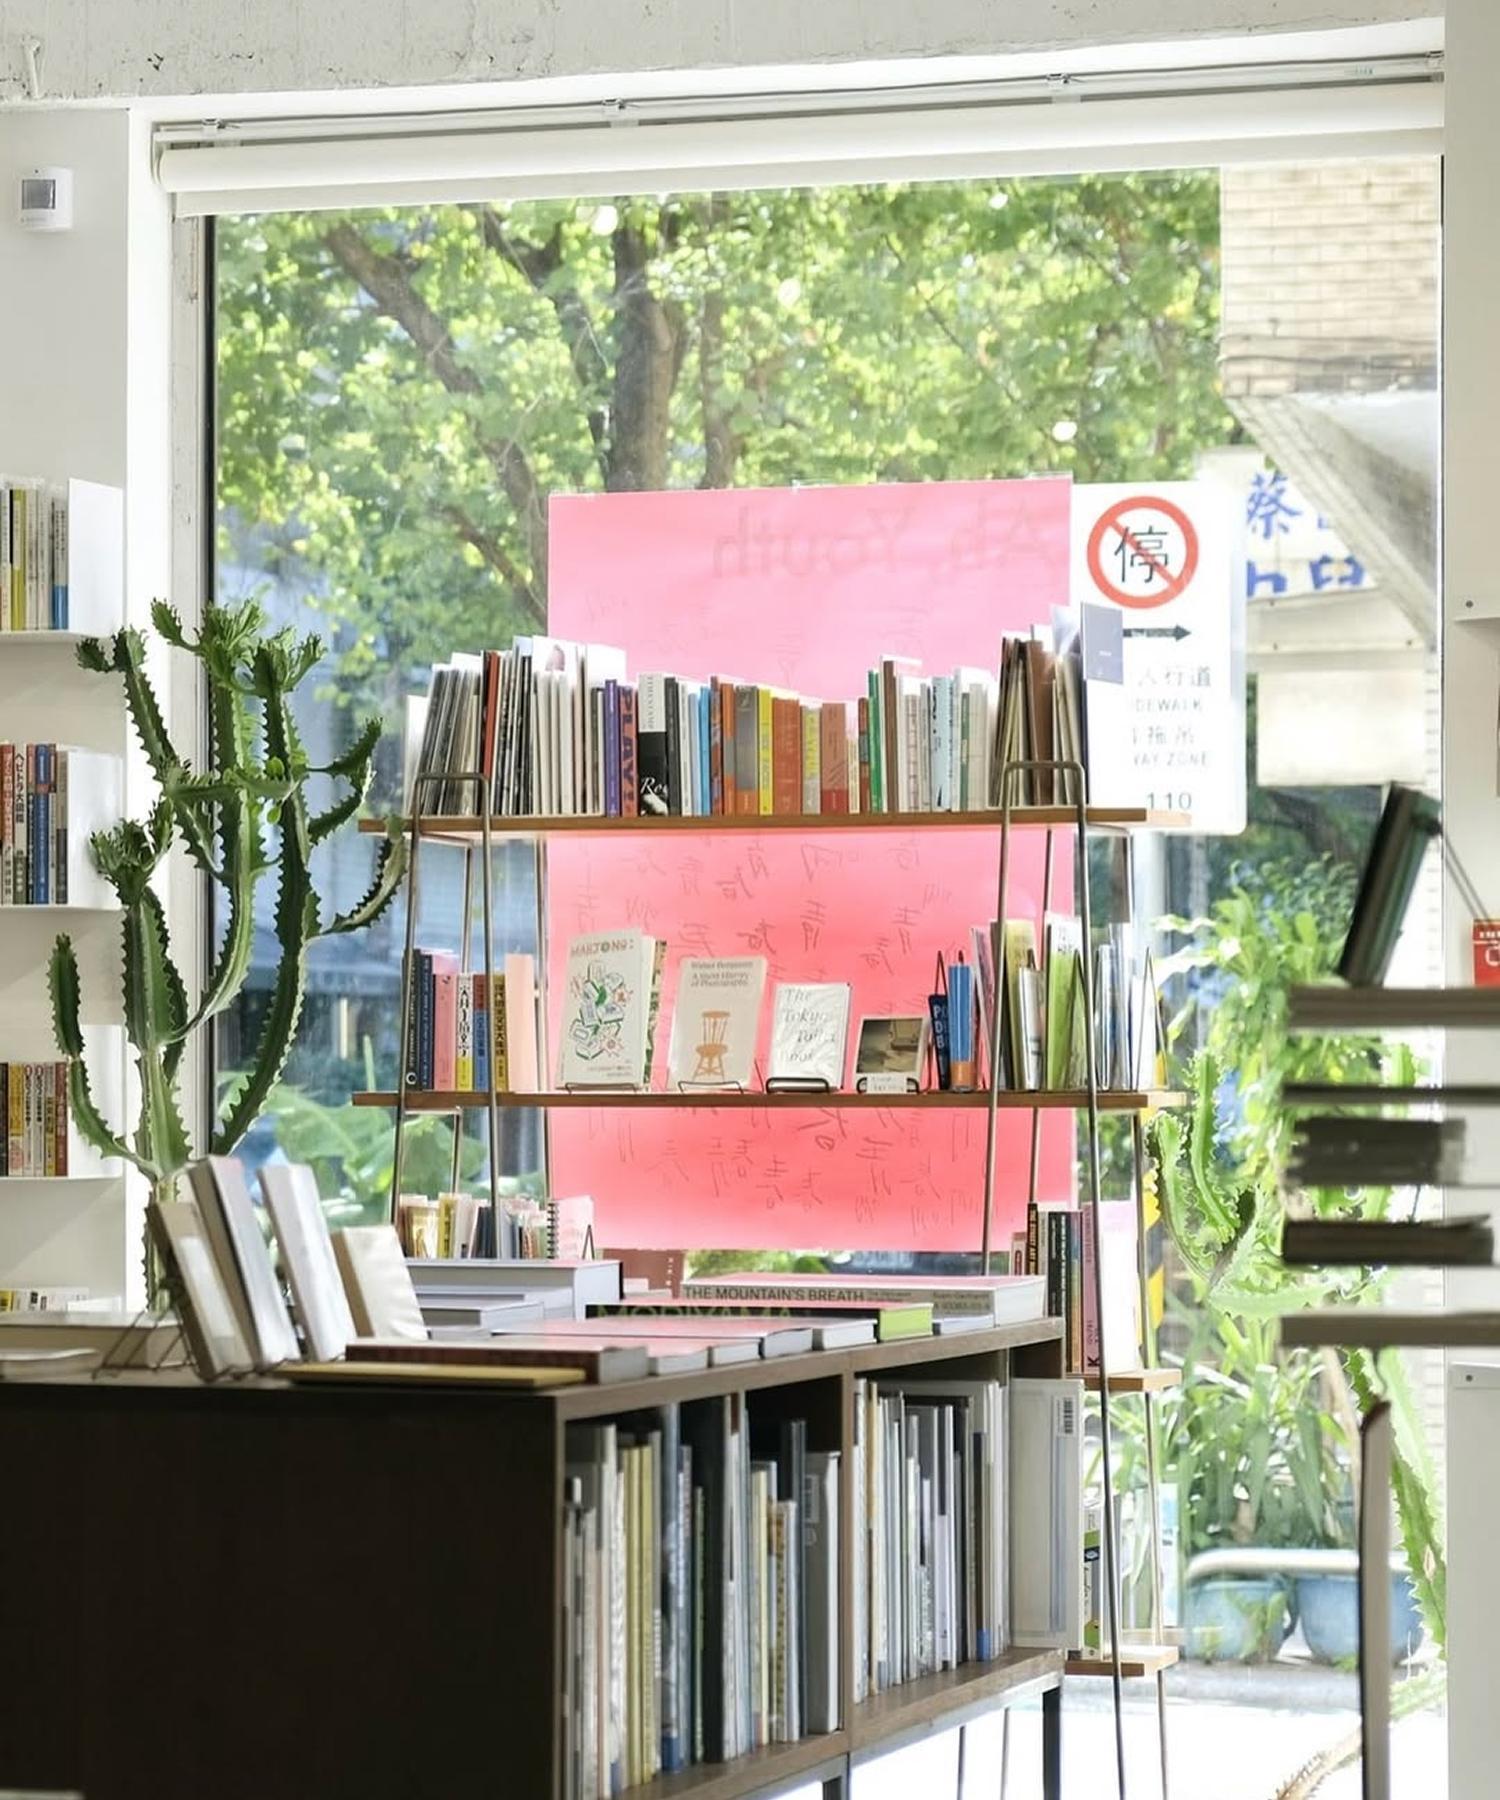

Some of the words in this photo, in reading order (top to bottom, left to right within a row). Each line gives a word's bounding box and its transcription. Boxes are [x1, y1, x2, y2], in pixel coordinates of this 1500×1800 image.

[1113, 525, 1169, 584] 停
[1137, 665, 1212, 688] 人行道
[1146, 791, 1193, 811] 110
[685, 1285, 714, 1300] THE
[715, 1286, 805, 1301] MOUNTAIN'S
[808, 1287, 865, 1302] BREATH
